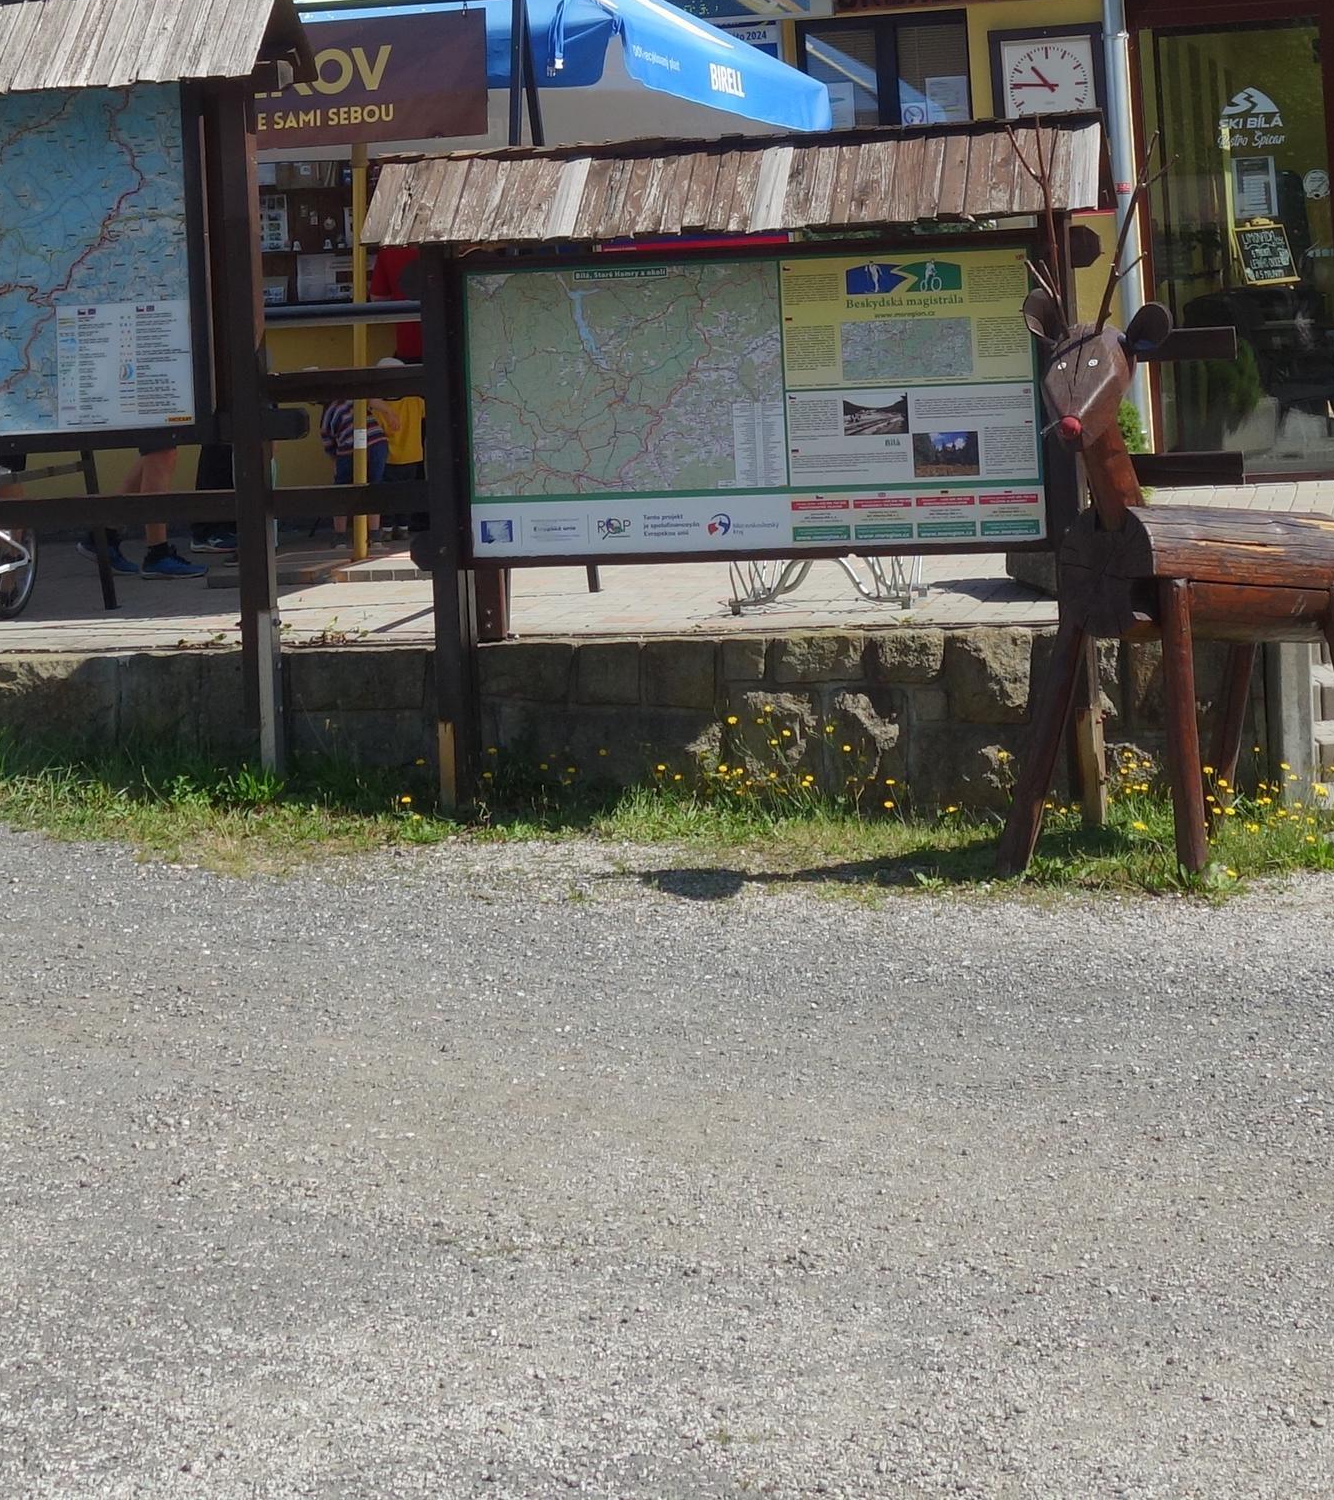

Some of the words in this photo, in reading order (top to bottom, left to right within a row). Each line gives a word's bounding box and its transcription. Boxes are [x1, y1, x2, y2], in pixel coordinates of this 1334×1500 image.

[746, 30, 768, 42] 2024
[709, 62, 746, 98] BIRELL
[273, 108, 321, 130] SAMI
[328, 103, 394, 126] SEBOU
[1218, 117, 1243, 130] SKI
[1246, 113, 1284, 129] BÍLÁ
[845, 296, 904, 311] Beskydská
[906, 293, 964, 309] magistrála
